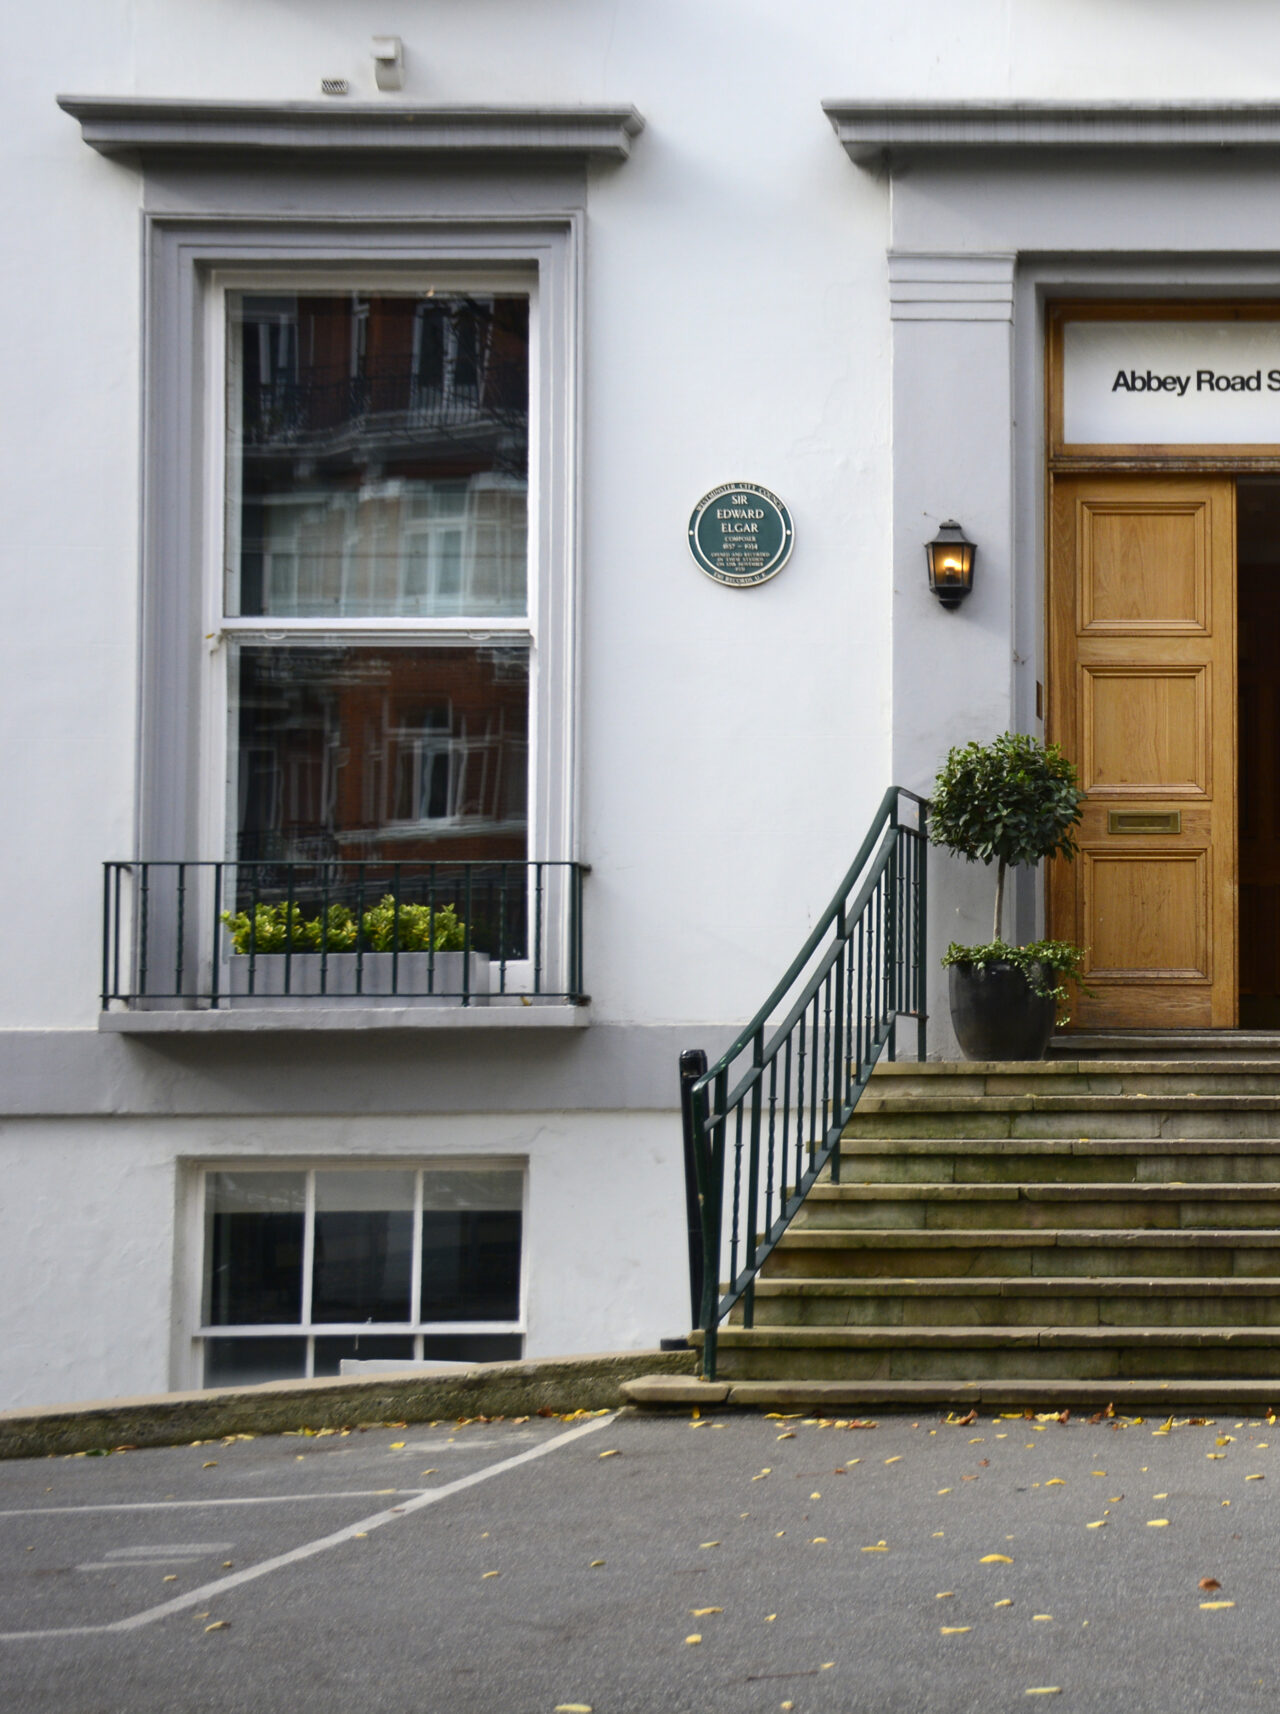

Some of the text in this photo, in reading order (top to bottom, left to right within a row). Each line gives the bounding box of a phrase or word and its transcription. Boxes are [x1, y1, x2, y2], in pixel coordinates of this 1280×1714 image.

[1111, 370, 1191, 396] Abbey
[1196, 370, 1261, 392] Road
[739, 483, 757, 491] CITY
[731, 494, 748, 505] SIR
[716, 508, 764, 519] EDWARD
[721, 523, 759, 533] ELGAR
[725, 576, 753, 584] RECORDS
